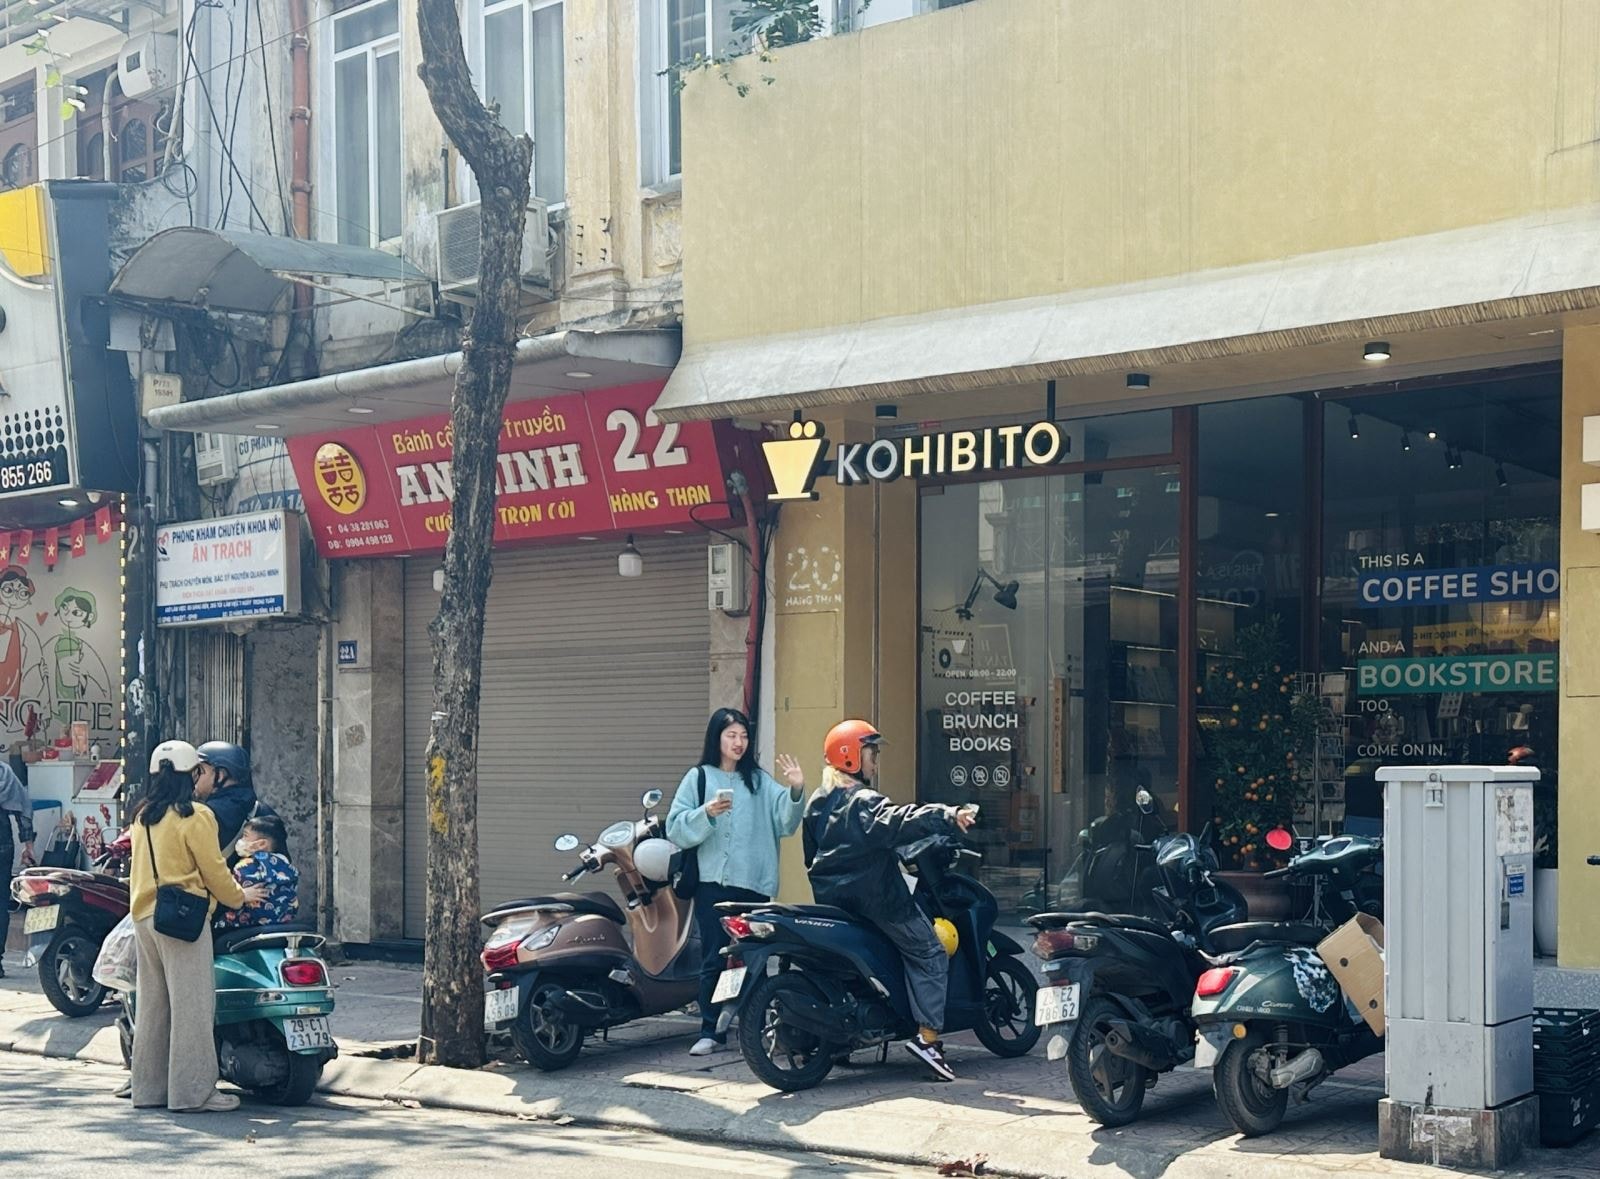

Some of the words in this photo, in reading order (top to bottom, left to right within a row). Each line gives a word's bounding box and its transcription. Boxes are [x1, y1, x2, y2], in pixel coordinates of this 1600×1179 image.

[392, 429, 433, 454] Bánh
[504, 405, 566, 439] truyền
[606, 404, 688, 472] 22
[837, 422, 1061, 484] KOHIBITO
[1, 465, 25, 489] 855
[28, 460, 52, 485] 266
[396, 461, 455, 506] AN
[495, 443, 588, 494] INH
[610, 487, 659, 513] HÀNG
[666, 485, 711, 507] THAN
[248, 519, 267, 534] KHOA
[268, 514, 281, 534] NỘI
[499, 504, 542, 526] TRỌN
[1359, 554, 1393, 569] THIS
[1396, 553, 1410, 566] IS
[1413, 553, 1425, 565] A
[1362, 573, 1478, 603] COFFEE
[1490, 568, 1560, 596] SHO
[1358, 641, 1390, 654] AND
[1393, 640, 1406, 653] A
[1360, 660, 1554, 688] BOOKSTORE
[945, 691, 1016, 705] COFFEE
[943, 713, 1018, 729] BRUNCH
[949, 737, 1012, 752] BOOKS
[1357, 744, 1398, 757] COME
[1402, 743, 1425, 756] ON
[1428, 743, 1447, 757] IN.
[794, 918, 835, 928] VISION
[291, 1018, 323, 1033] 29-C1
[290, 1032, 329, 1048] 231.79
